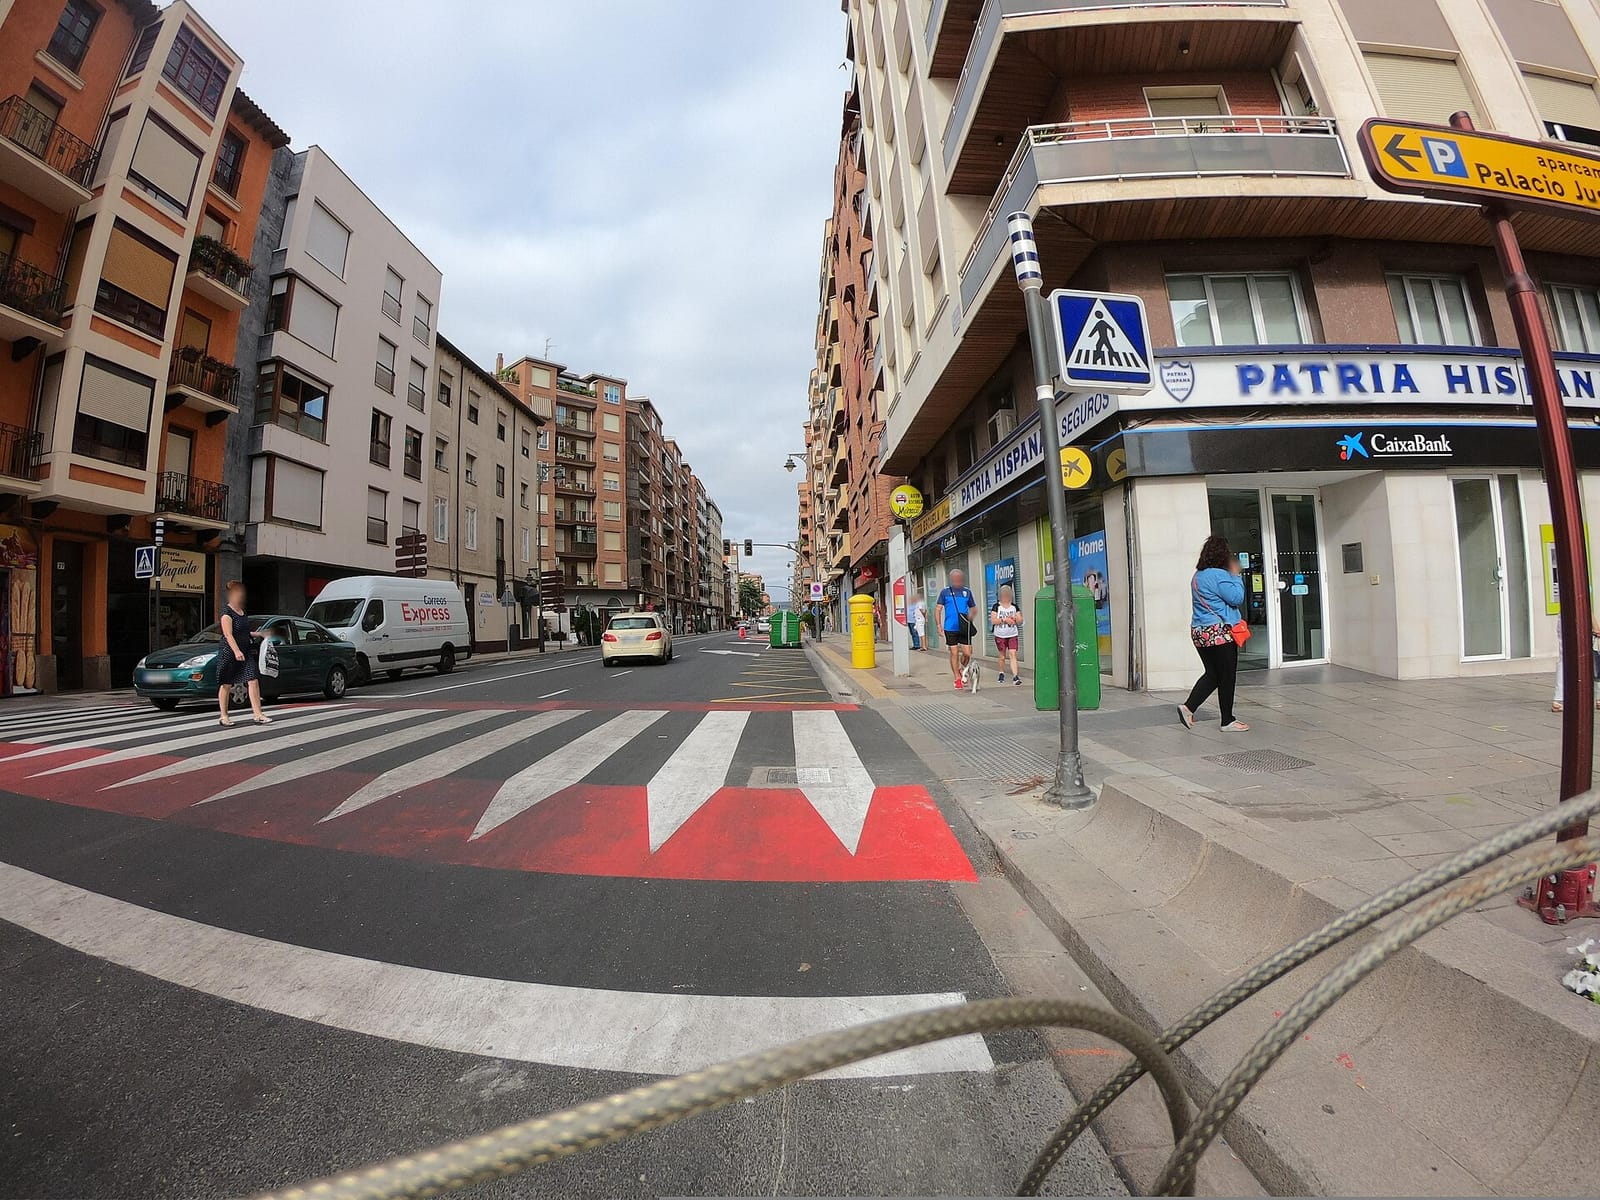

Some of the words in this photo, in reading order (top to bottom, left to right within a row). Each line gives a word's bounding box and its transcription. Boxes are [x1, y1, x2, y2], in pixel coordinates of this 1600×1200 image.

[1427, 140, 1456, 173] P
[1475, 163, 1565, 197] Palacio
[1234, 362, 1420, 396] PATRIA
[1443, 364, 1598, 399] HISN
[961, 470, 991, 507] PATRIA
[994, 432, 1043, 483] HISPAN
[1061, 393, 1109, 438] SEGUROS
[1371, 433, 1452, 453] CaixaBank
[1078, 539, 1104, 557] Home
[160, 560, 198, 582] Paquita
[995, 564, 1015, 581] Home
[424, 595, 447, 605] Correos
[401, 603, 450, 625] Express
